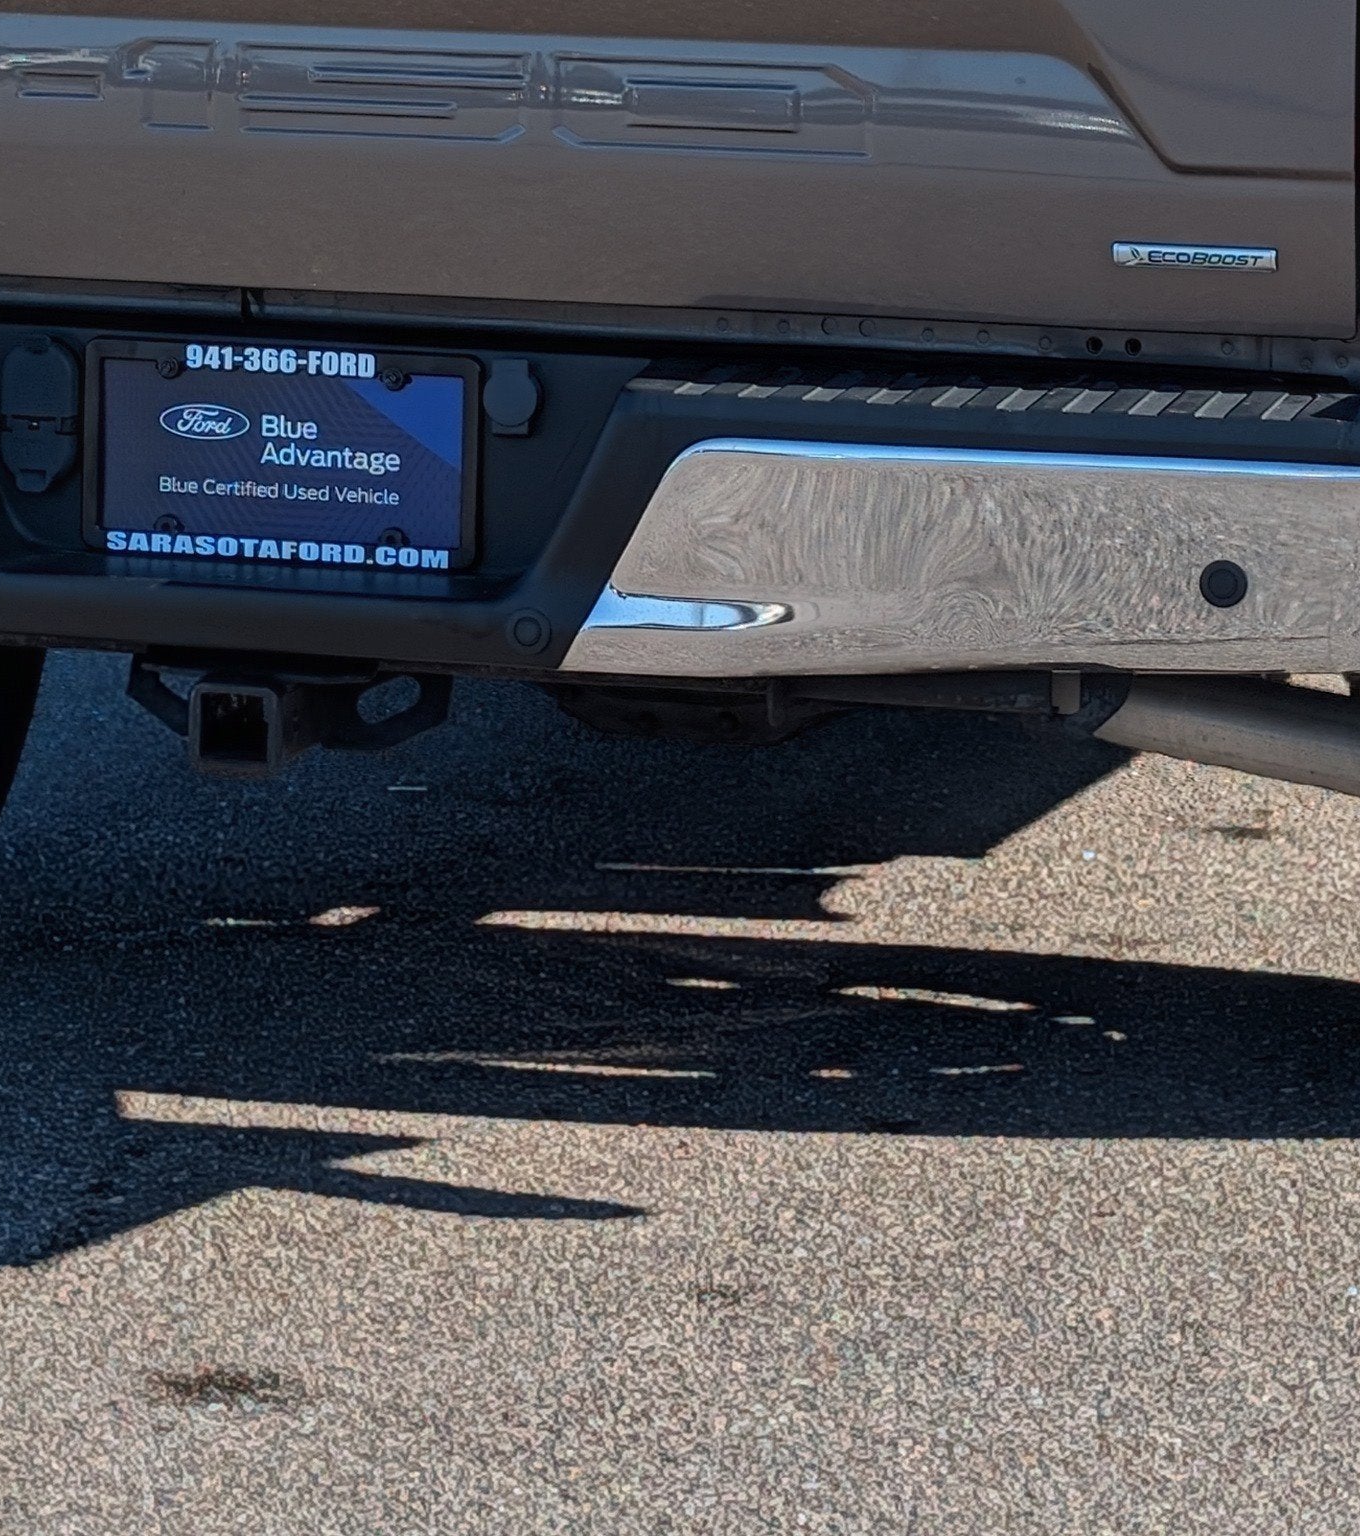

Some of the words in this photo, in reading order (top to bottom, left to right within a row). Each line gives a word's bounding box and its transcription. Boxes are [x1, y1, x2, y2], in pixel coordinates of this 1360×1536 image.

[186, 344, 376, 379] 941-366-FORD
[176, 408, 233, 435] Ford
[261, 415, 318, 440] Blue
[260, 442, 401, 475] Advantage
[159, 476, 198, 494] Blue
[203, 479, 279, 499] Certified
[284, 483, 330, 501] Used
[335, 486, 400, 505] Vehicle
[107, 530, 450, 570] SARASOTAFORD.COM
